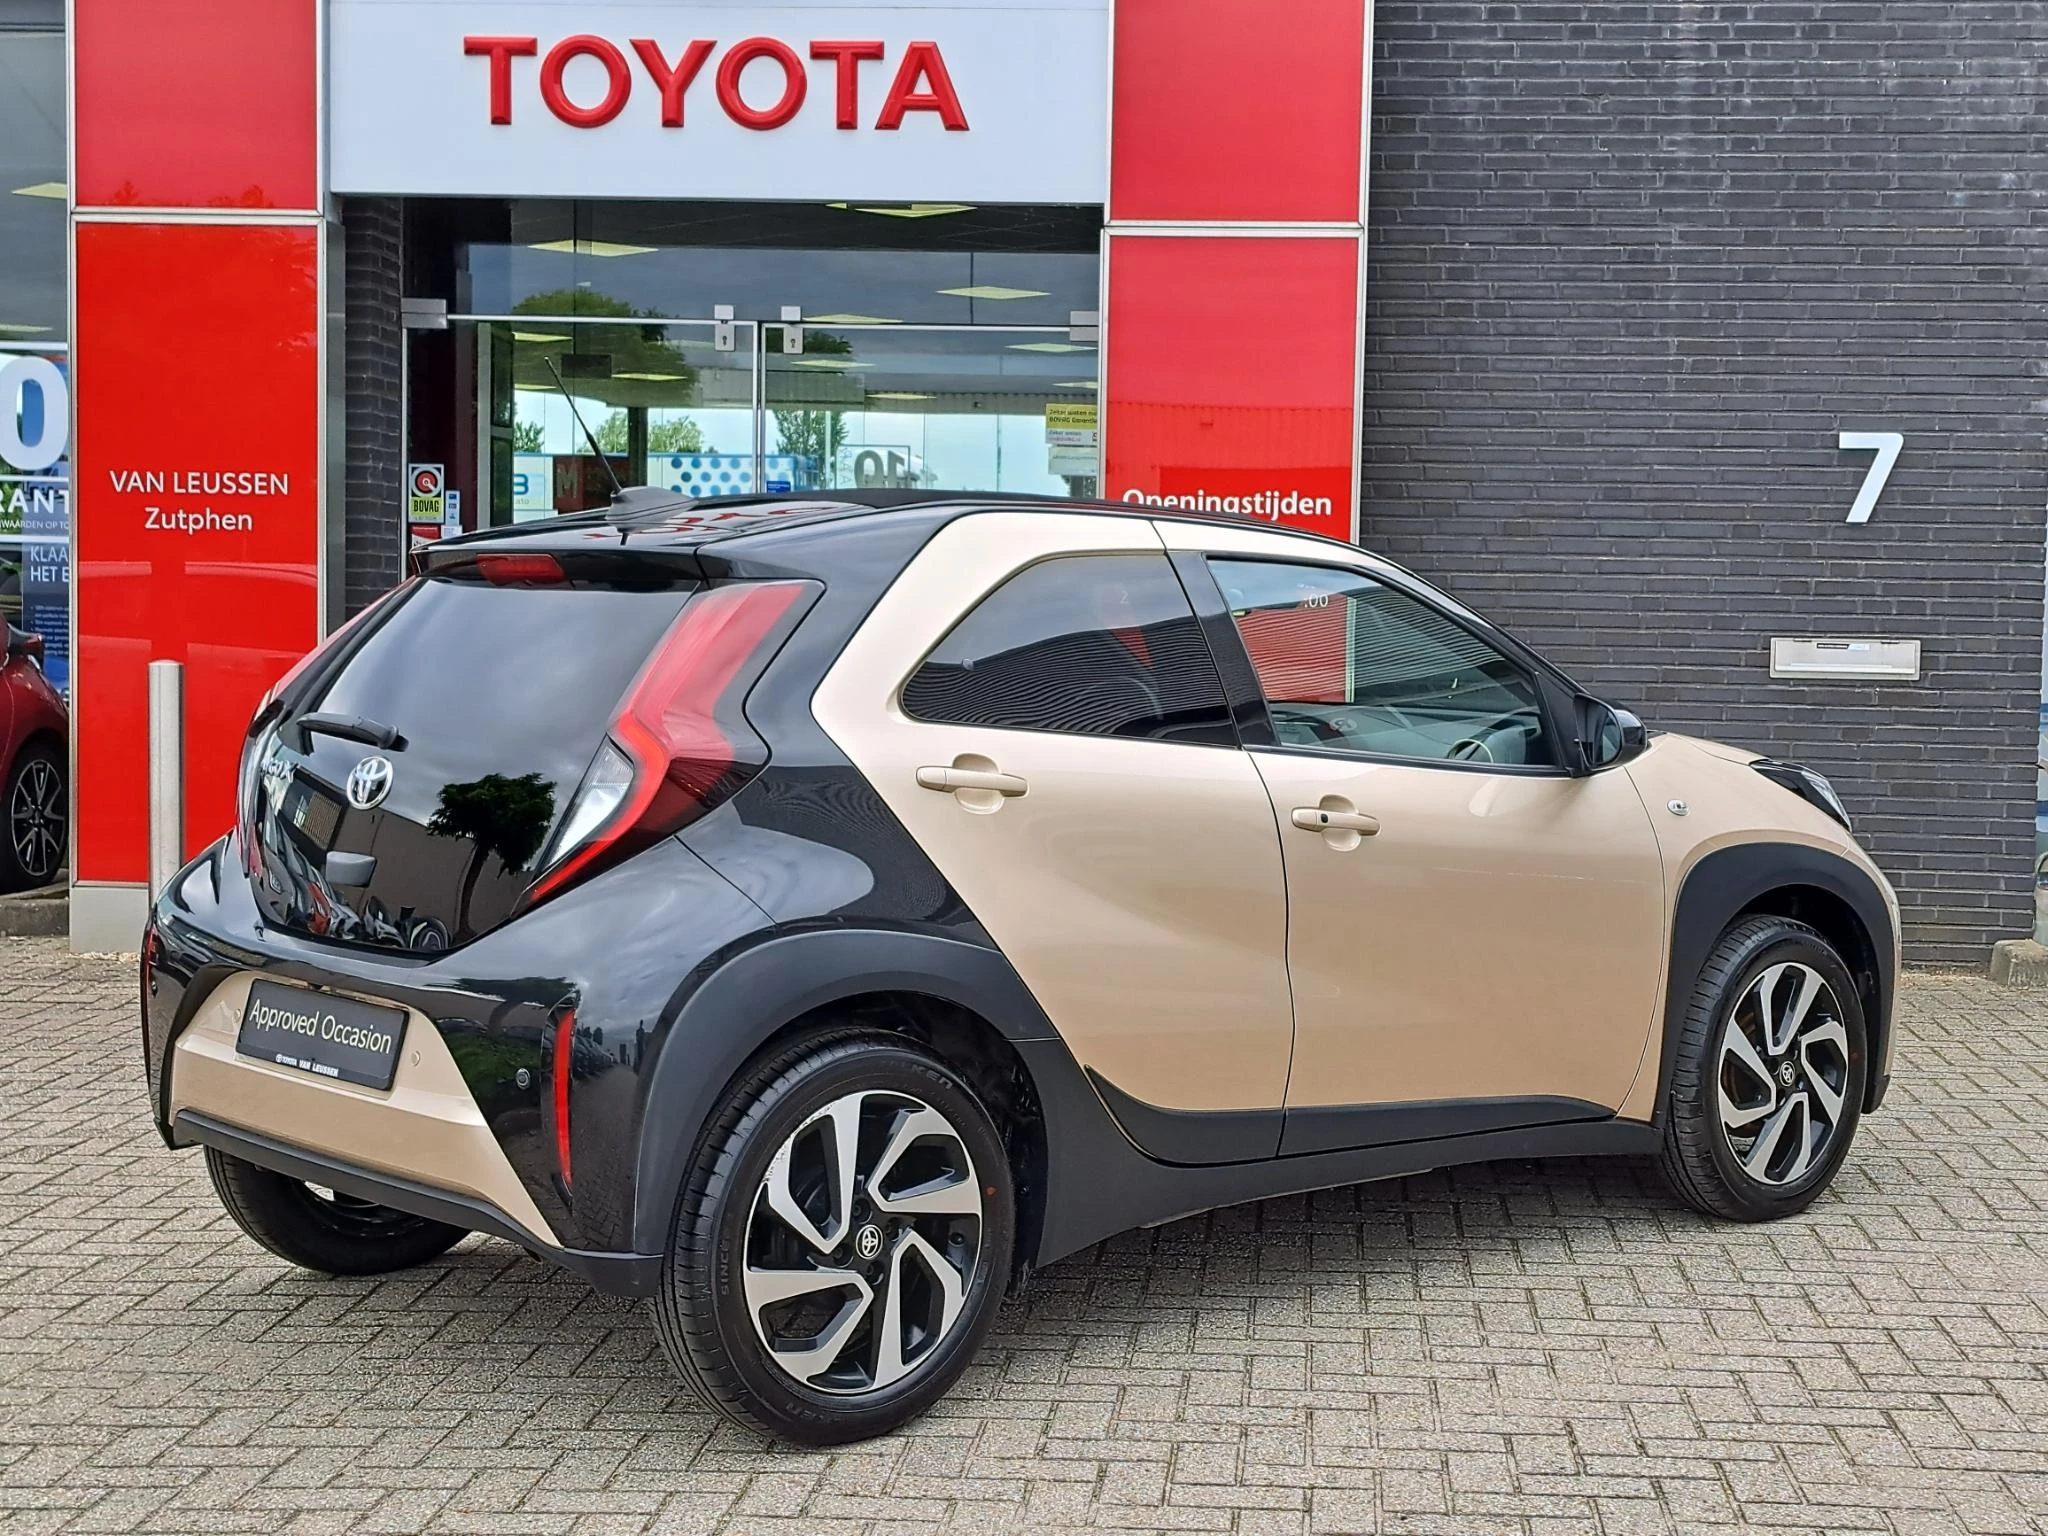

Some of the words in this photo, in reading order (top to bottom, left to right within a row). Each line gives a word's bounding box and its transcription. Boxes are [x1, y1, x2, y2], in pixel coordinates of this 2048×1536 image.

[463, 33, 970, 131] TOYOTA
[109, 470, 165, 493] VAN
[173, 472, 289, 495] LEUSSEN
[1839, 432, 1904, 523] 7
[413, 500, 440, 513] BOVAG
[0, 519, 43, 530] WAARDEN
[144, 507, 253, 535] Zutphen
[30, 565, 58, 582] HET
[249, 998, 320, 1037] Approved
[321, 1015, 392, 1054] Occasion
[299, 1059, 311, 1071] VAN
[312, 1062, 339, 1077] LEUSSEN
